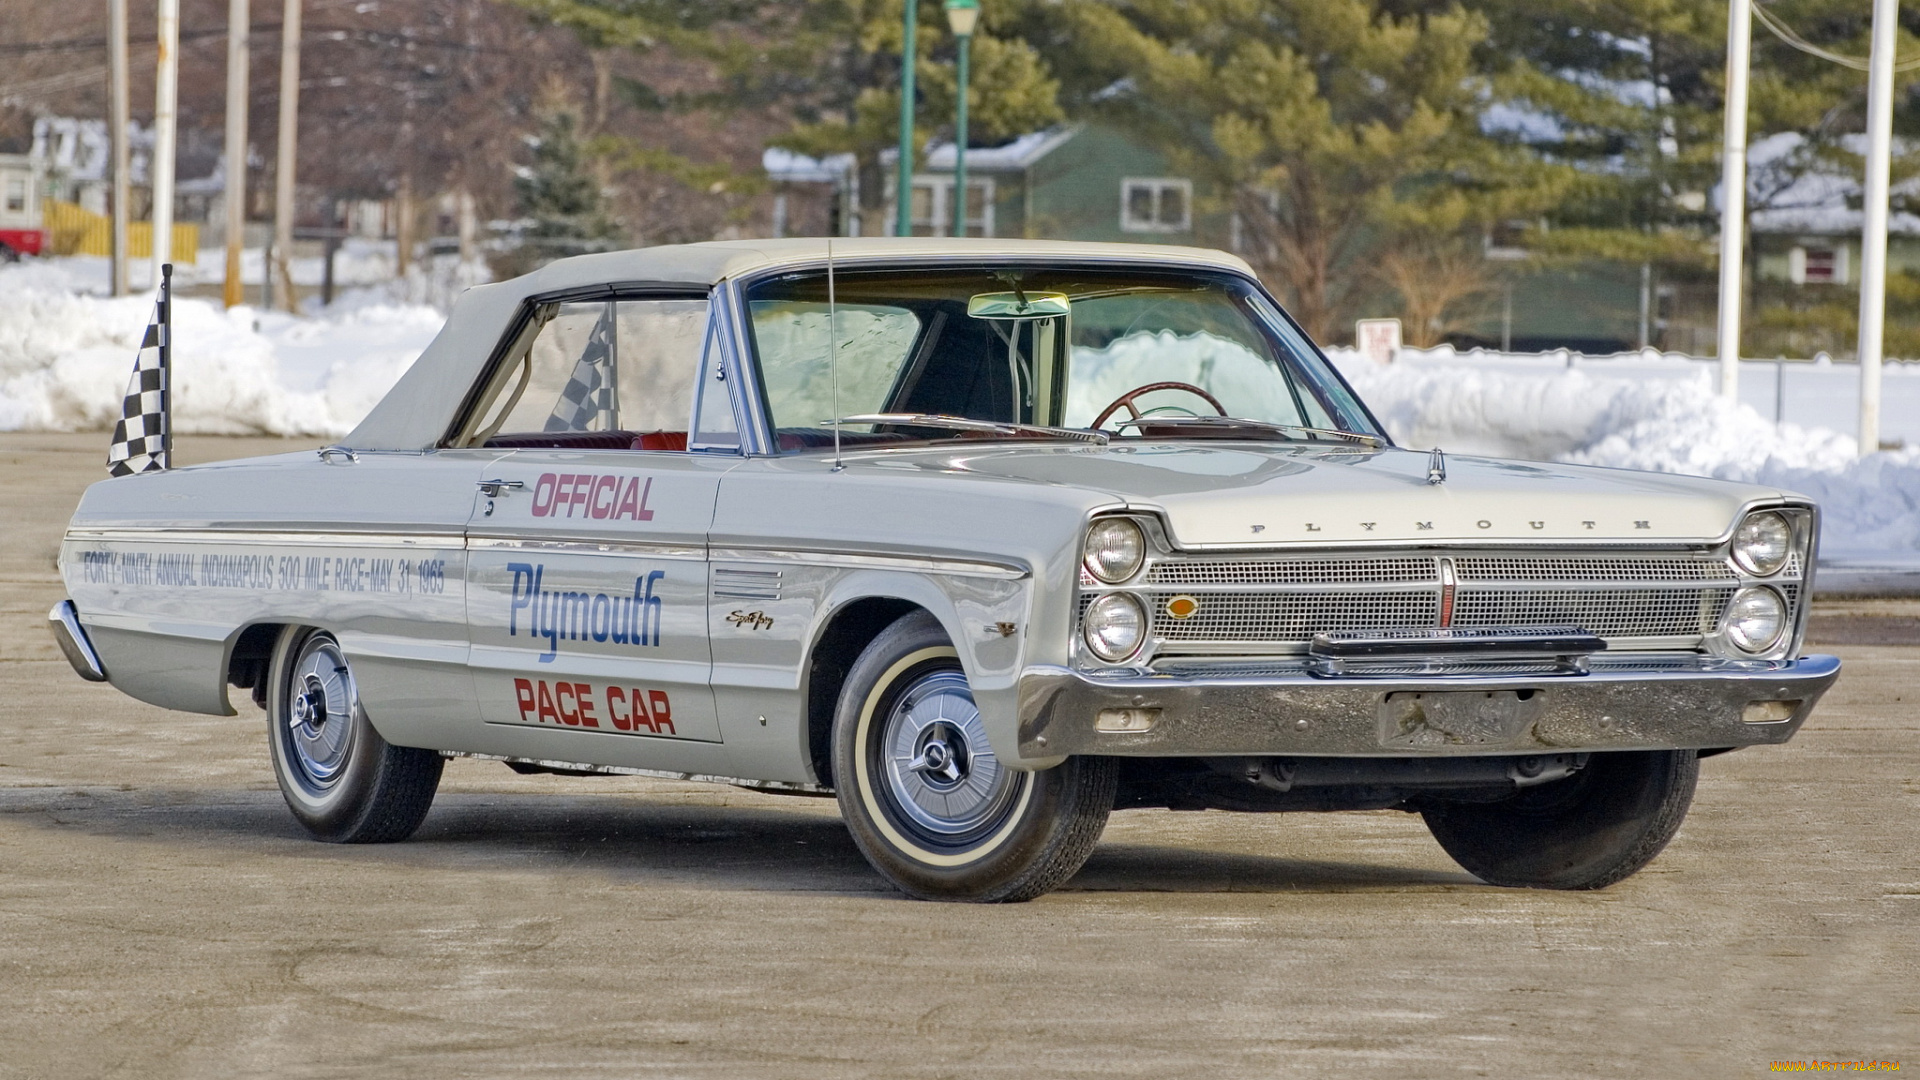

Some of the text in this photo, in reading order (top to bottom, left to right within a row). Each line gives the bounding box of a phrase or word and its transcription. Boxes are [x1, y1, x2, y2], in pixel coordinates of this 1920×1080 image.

[531, 473, 655, 522] OFFICIAL
[1250, 520, 1652, 535] PLYMOUTH
[84, 551, 152, 585] FORTY-NINTH
[156, 553, 197, 587] ANNUAL
[202, 554, 274, 589] INDIANAPOLIS
[279, 556, 301, 590] 500
[305, 557, 331, 591] MILE
[418, 559, 446, 594] 1965
[507, 562, 665, 663] Plymouth
[514, 678, 677, 736] PACE CAR
